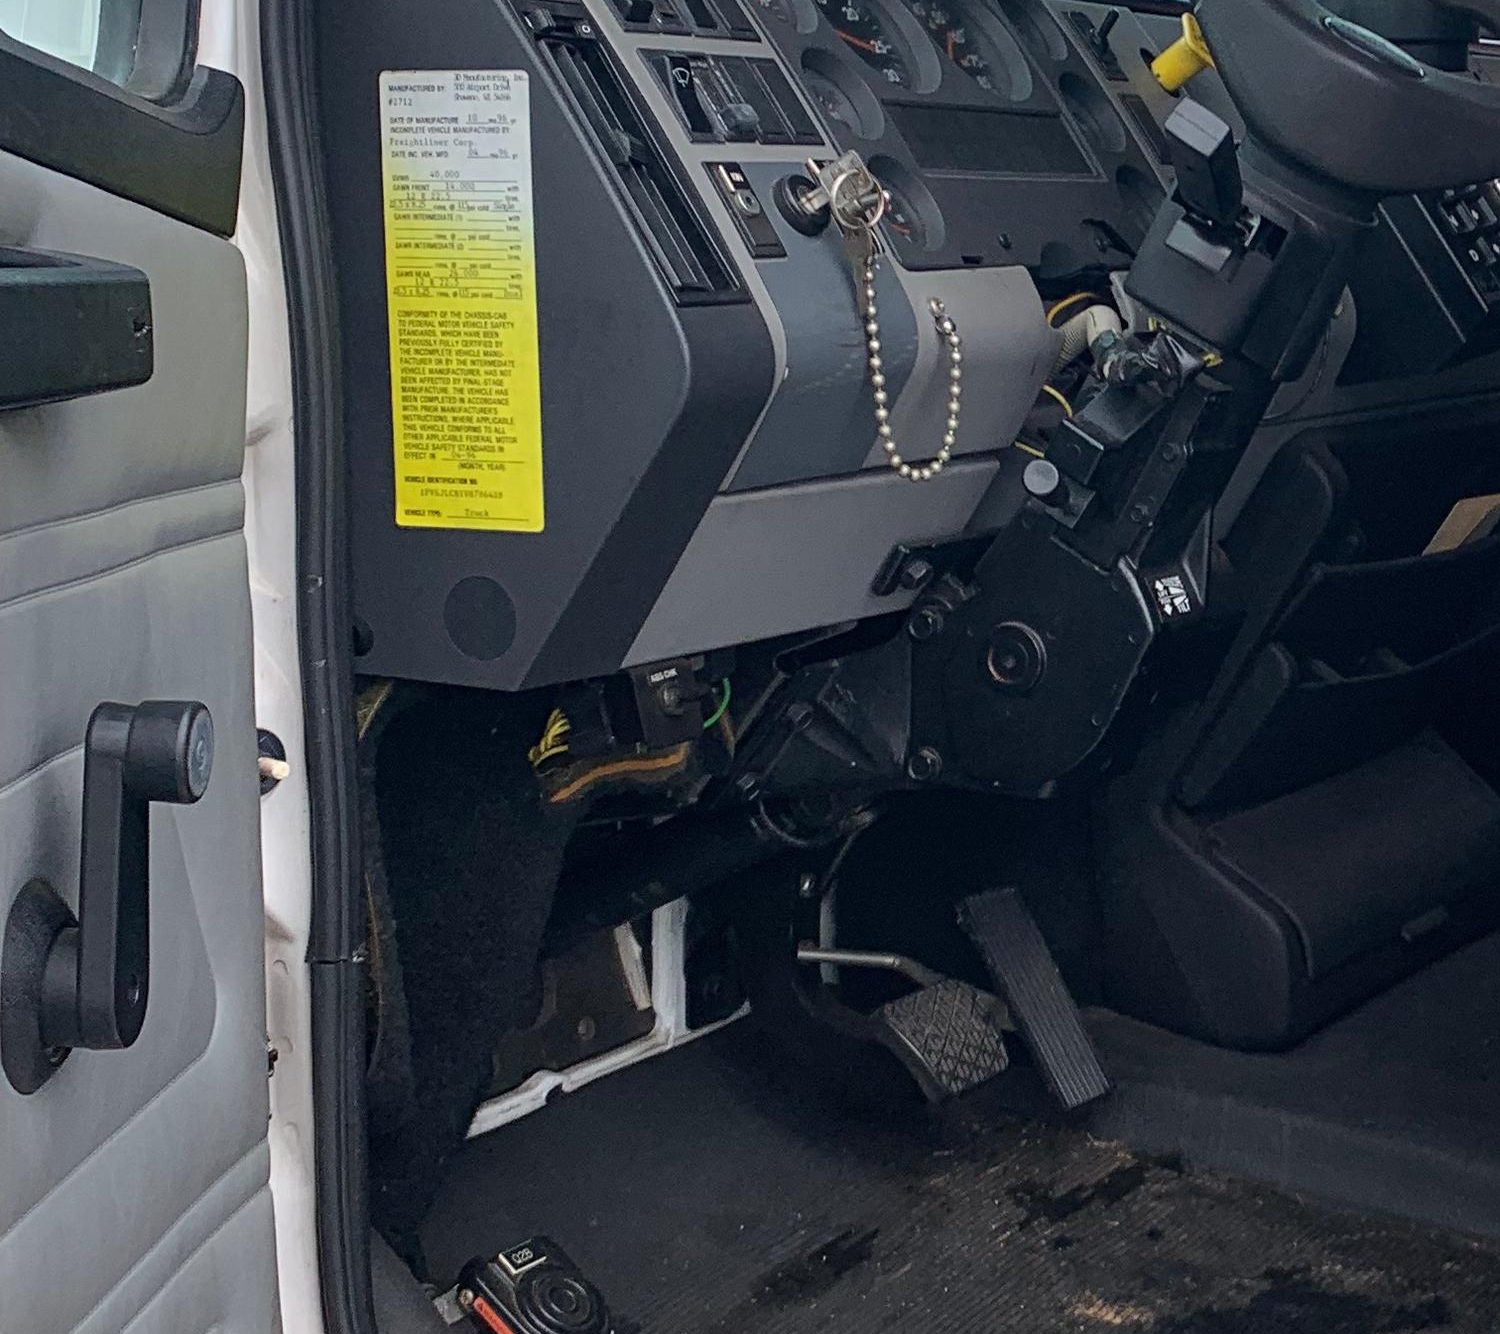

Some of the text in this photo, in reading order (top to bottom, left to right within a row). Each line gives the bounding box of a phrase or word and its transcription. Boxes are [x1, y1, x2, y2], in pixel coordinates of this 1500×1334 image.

[390, 139, 474, 147] Freightliner Corp.
[430, 171, 460, 179] 40,000
[439, 339, 459, 347] FULLY
[414, 348, 453, 356] INCOMPLETE
[455, 349, 480, 357] VEHICLE
[470, 360, 515, 368] INTERMEDIATE
[401, 367, 426, 375] VEHICLE
[420, 396, 457, 404] COMPLETED
[447, 425, 481, 433] CONFORMS
[465, 435, 492, 443] FEDERAL
[464, 509, 489, 517] Truck
